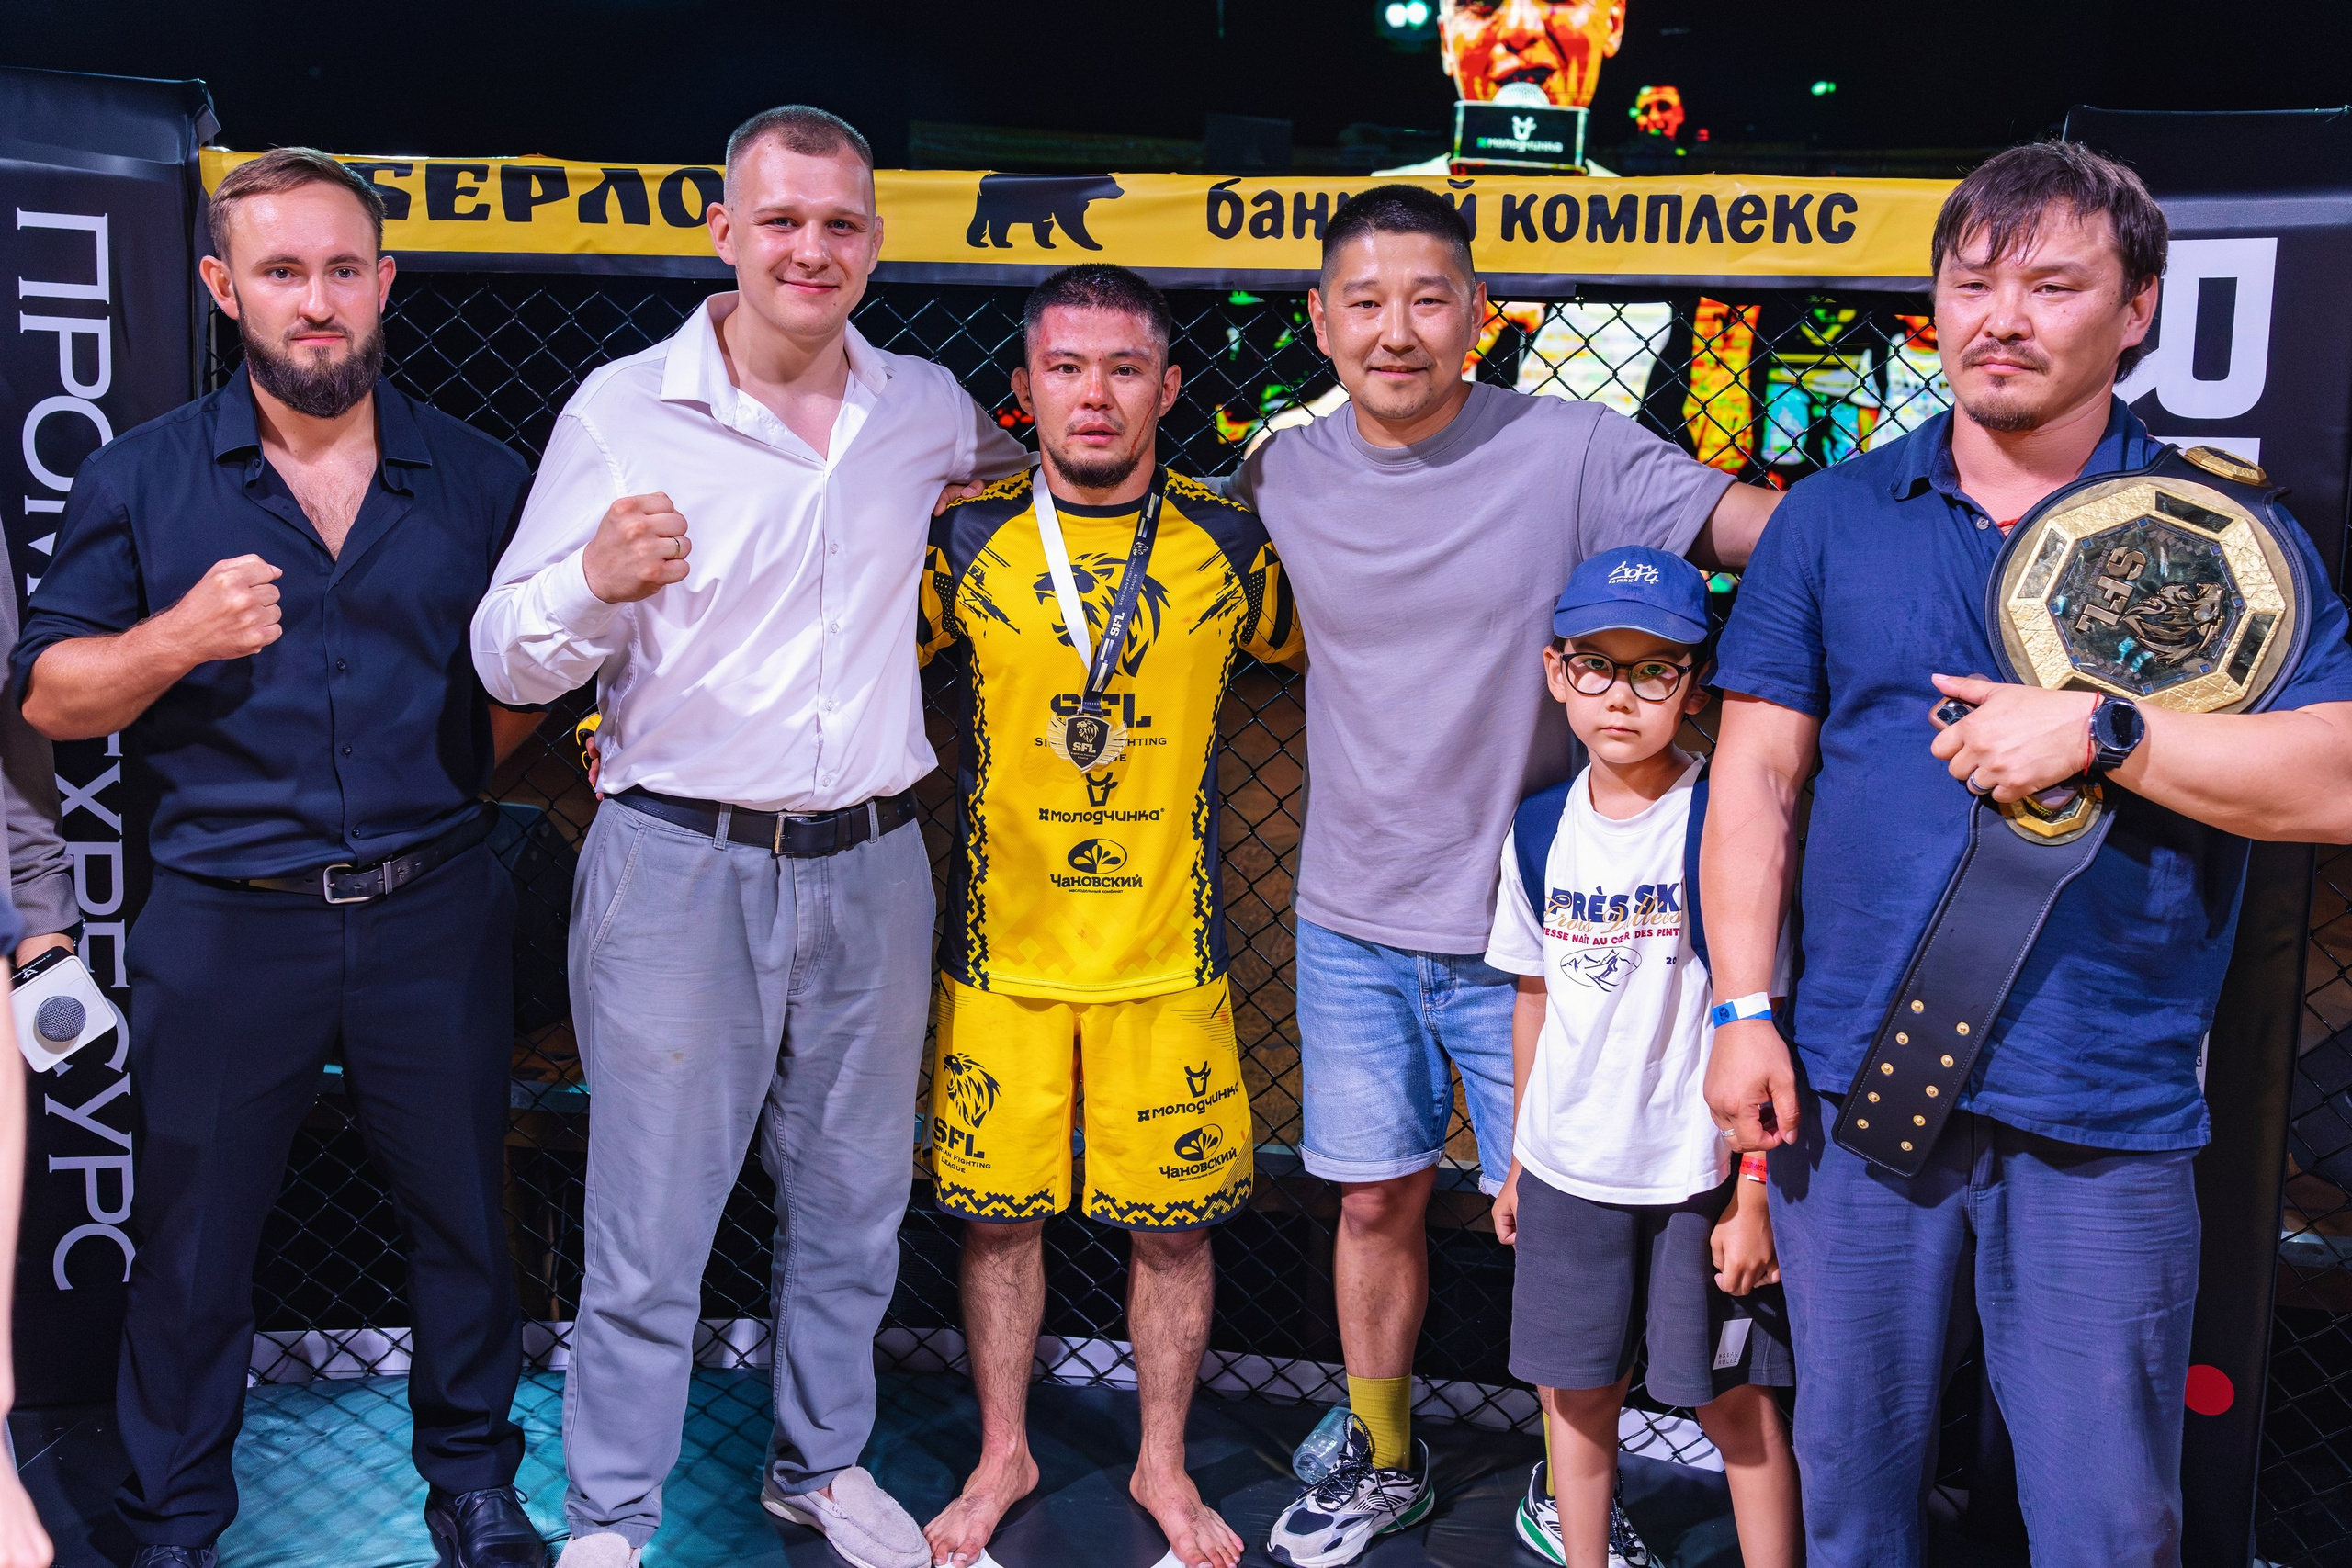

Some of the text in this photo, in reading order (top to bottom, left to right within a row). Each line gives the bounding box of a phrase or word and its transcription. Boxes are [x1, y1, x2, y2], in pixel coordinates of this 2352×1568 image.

[342, 162, 726, 229] БЕРЛО
[1206, 178, 1858, 244] банй комплекс
[1109, 612, 1125, 637] SFL
[1072, 742, 1096, 753] SFL
[1127, 737, 1167, 747] HTING
[1050, 874, 1143, 888] Чановский
[1547, 883, 1680, 923] PRÈS SK
[1592, 937, 1608, 945] AU
[1634, 929, 1653, 939] DES
[1657, 928, 1680, 937] PENT
[933, 1116, 985, 1159] SFL
[941, 1156, 966, 1173] LEAGUE
[954, 1154, 991, 1169] FIGHTING
[1159, 1146, 1238, 1179] Чановский
